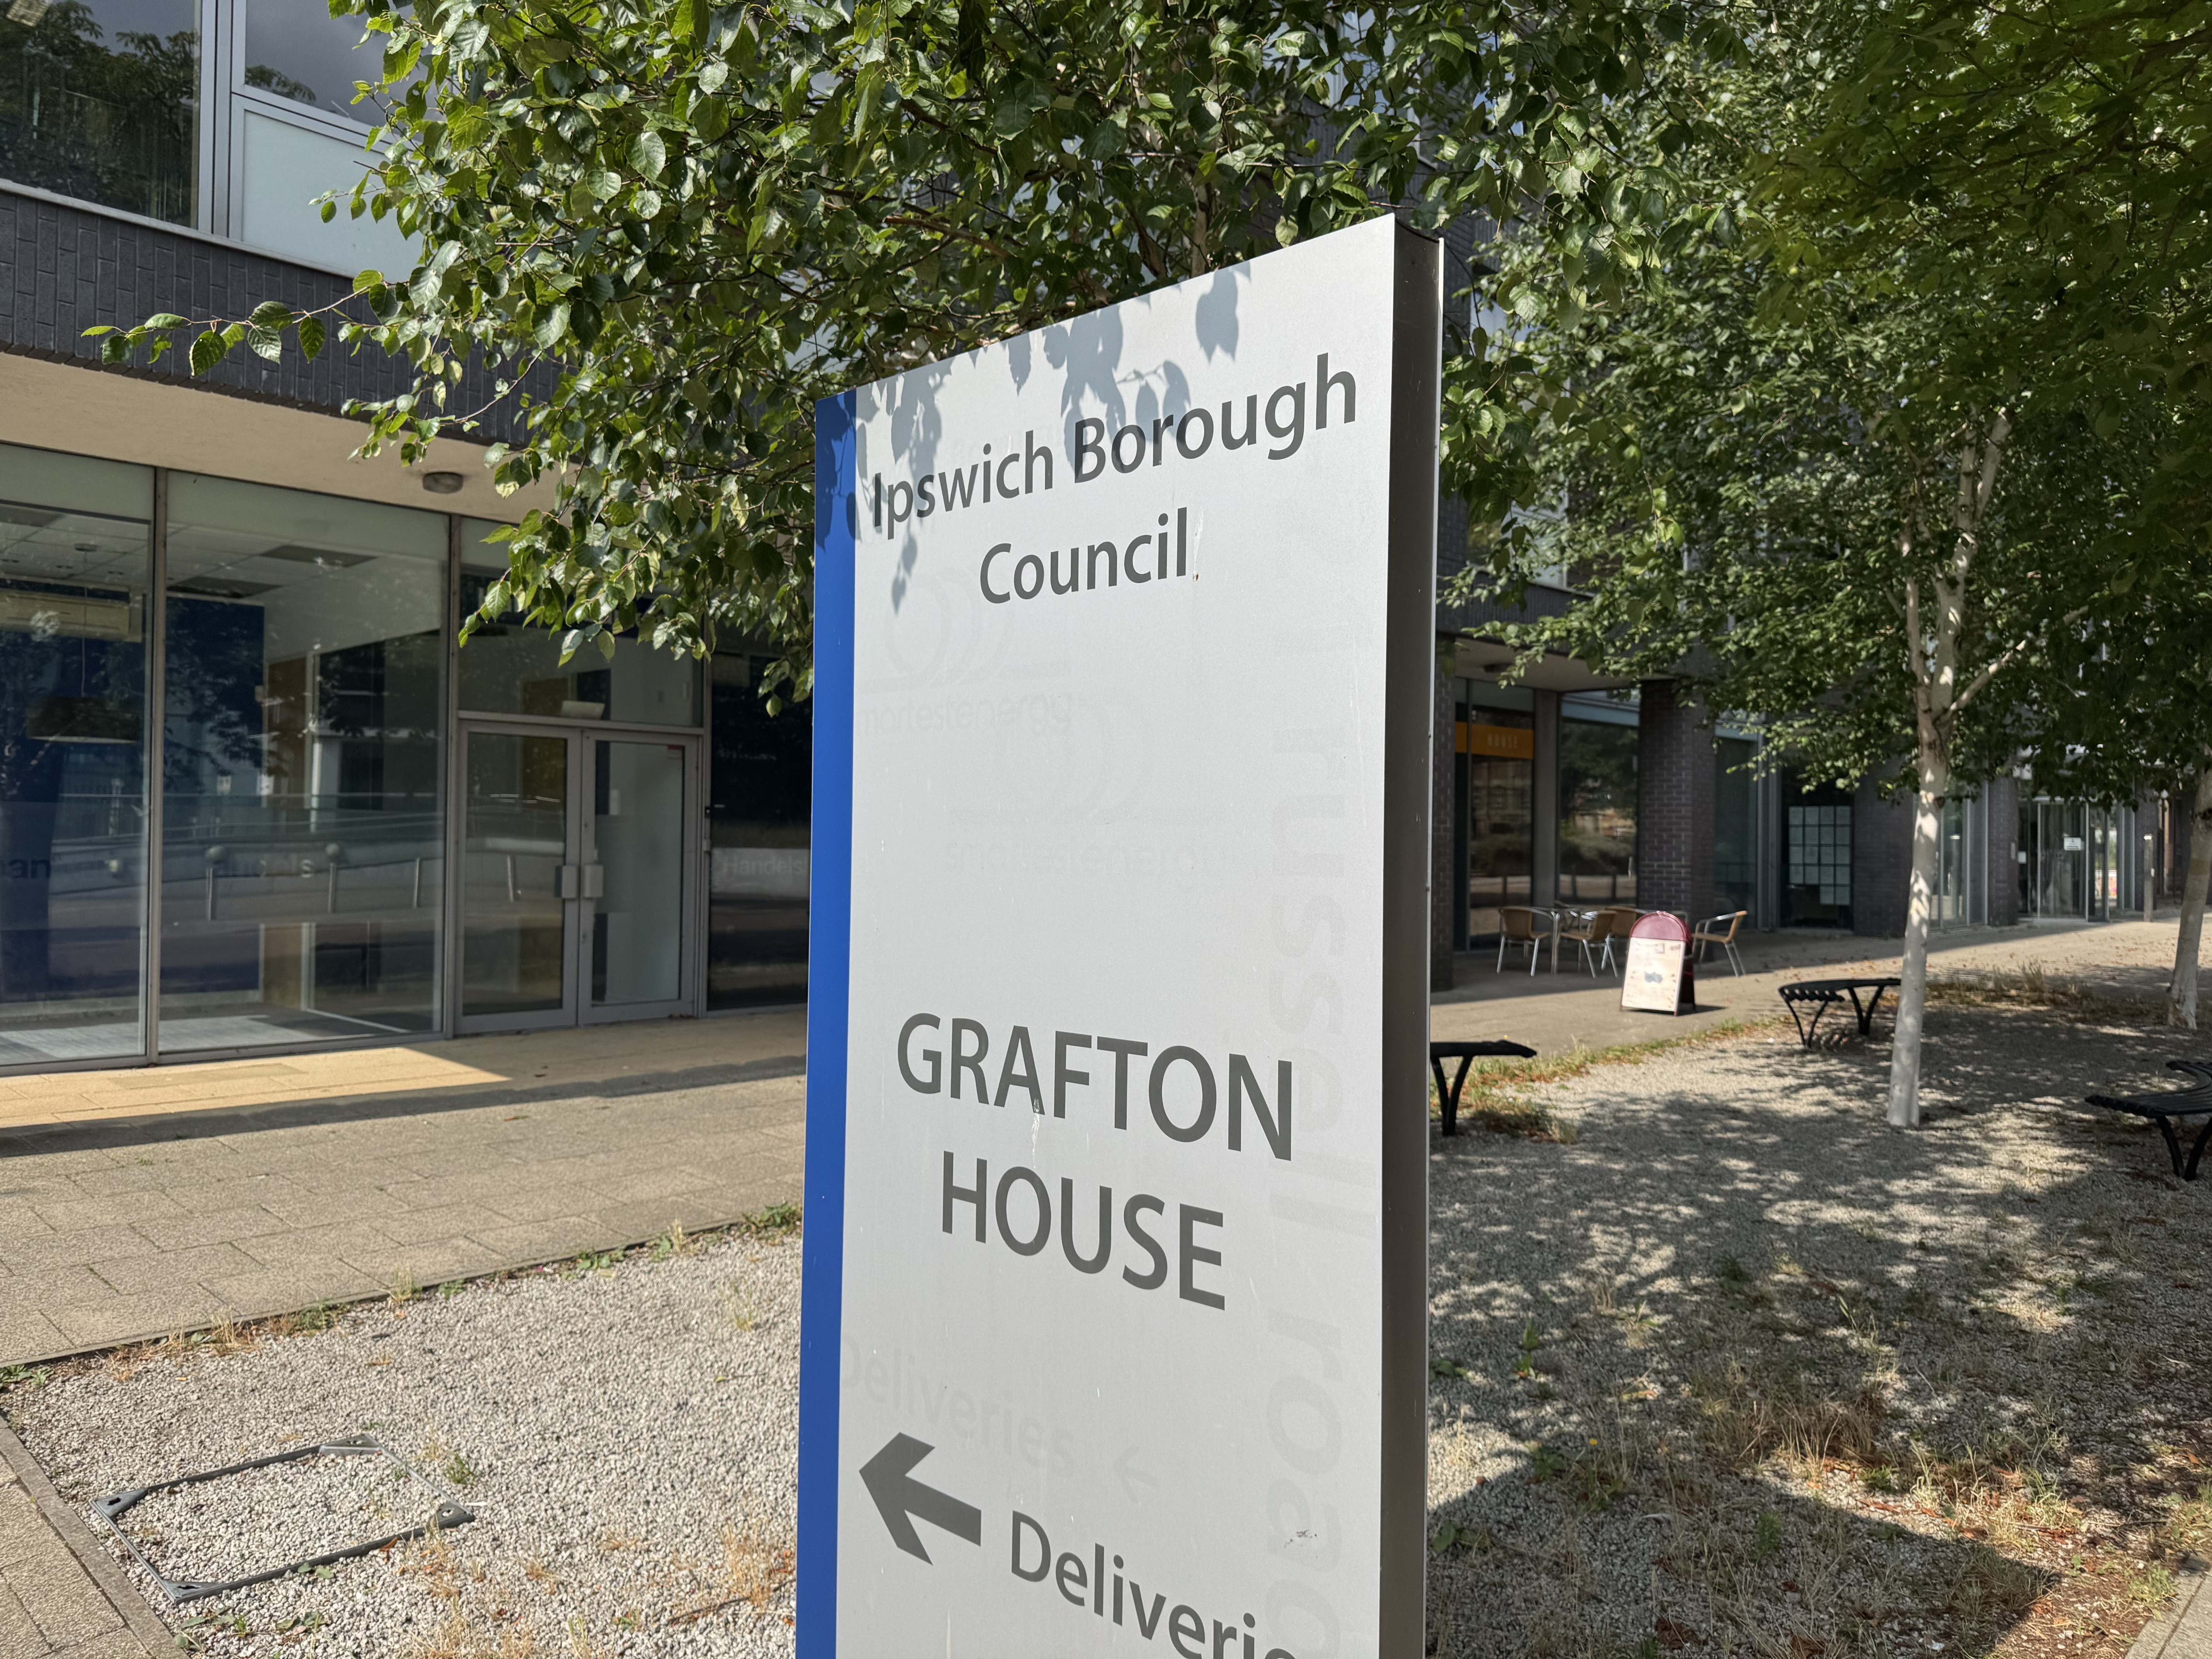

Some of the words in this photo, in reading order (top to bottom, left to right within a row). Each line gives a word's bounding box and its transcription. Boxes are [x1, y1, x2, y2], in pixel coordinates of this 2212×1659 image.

[872, 429, 1054, 541] Ipswich
[1073, 351, 1357, 484] Borough
[979, 506, 1188, 605] Council
[1268, 726, 1375, 1237] russell
[897, 1012, 1293, 1162] GRAFTON
[941, 1150, 1226, 1311] HOUSE
[1011, 1510, 1297, 1659] Deliveri
